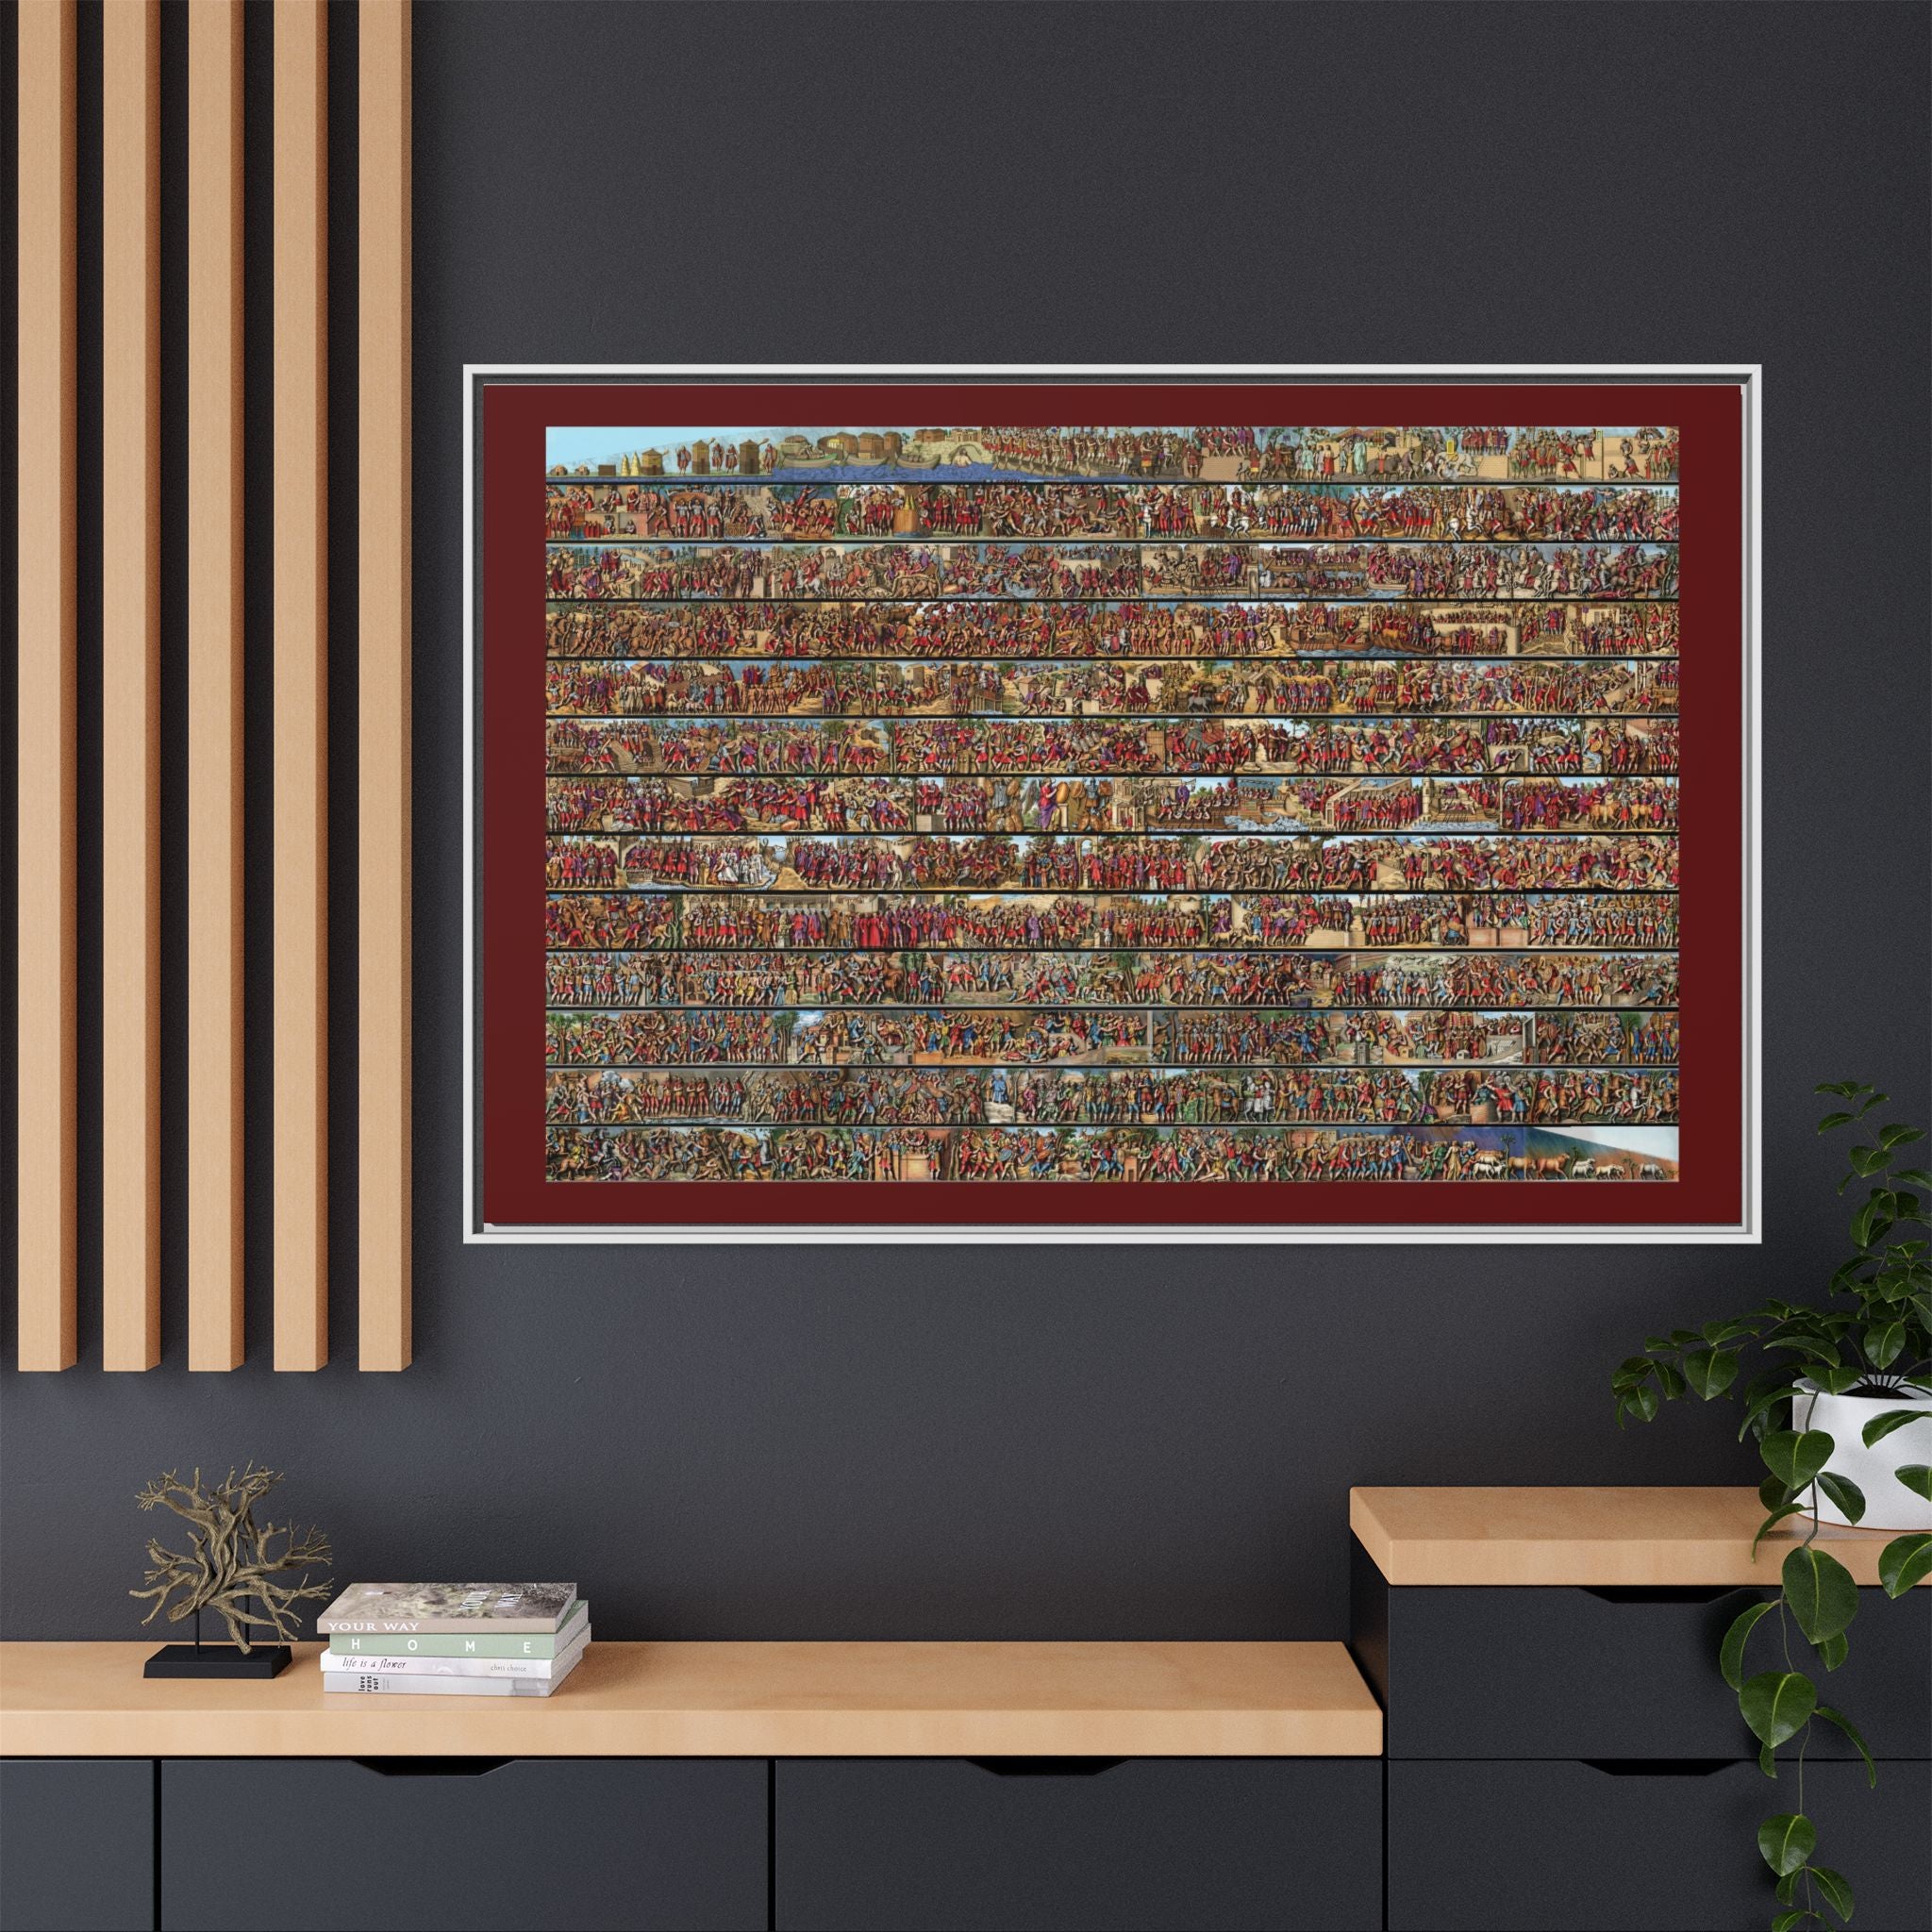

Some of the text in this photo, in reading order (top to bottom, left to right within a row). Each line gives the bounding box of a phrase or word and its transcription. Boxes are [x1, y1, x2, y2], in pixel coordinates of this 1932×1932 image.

[328, 1623, 420, 1631] YOUR WAY
[351, 1638, 531, 1654] HOME
[341, 1657, 358, 1671] life
[359, 1659, 367, 1668] is
[377, 1658, 408, 1671] flower
[507, 1664, 527, 1673] choice
